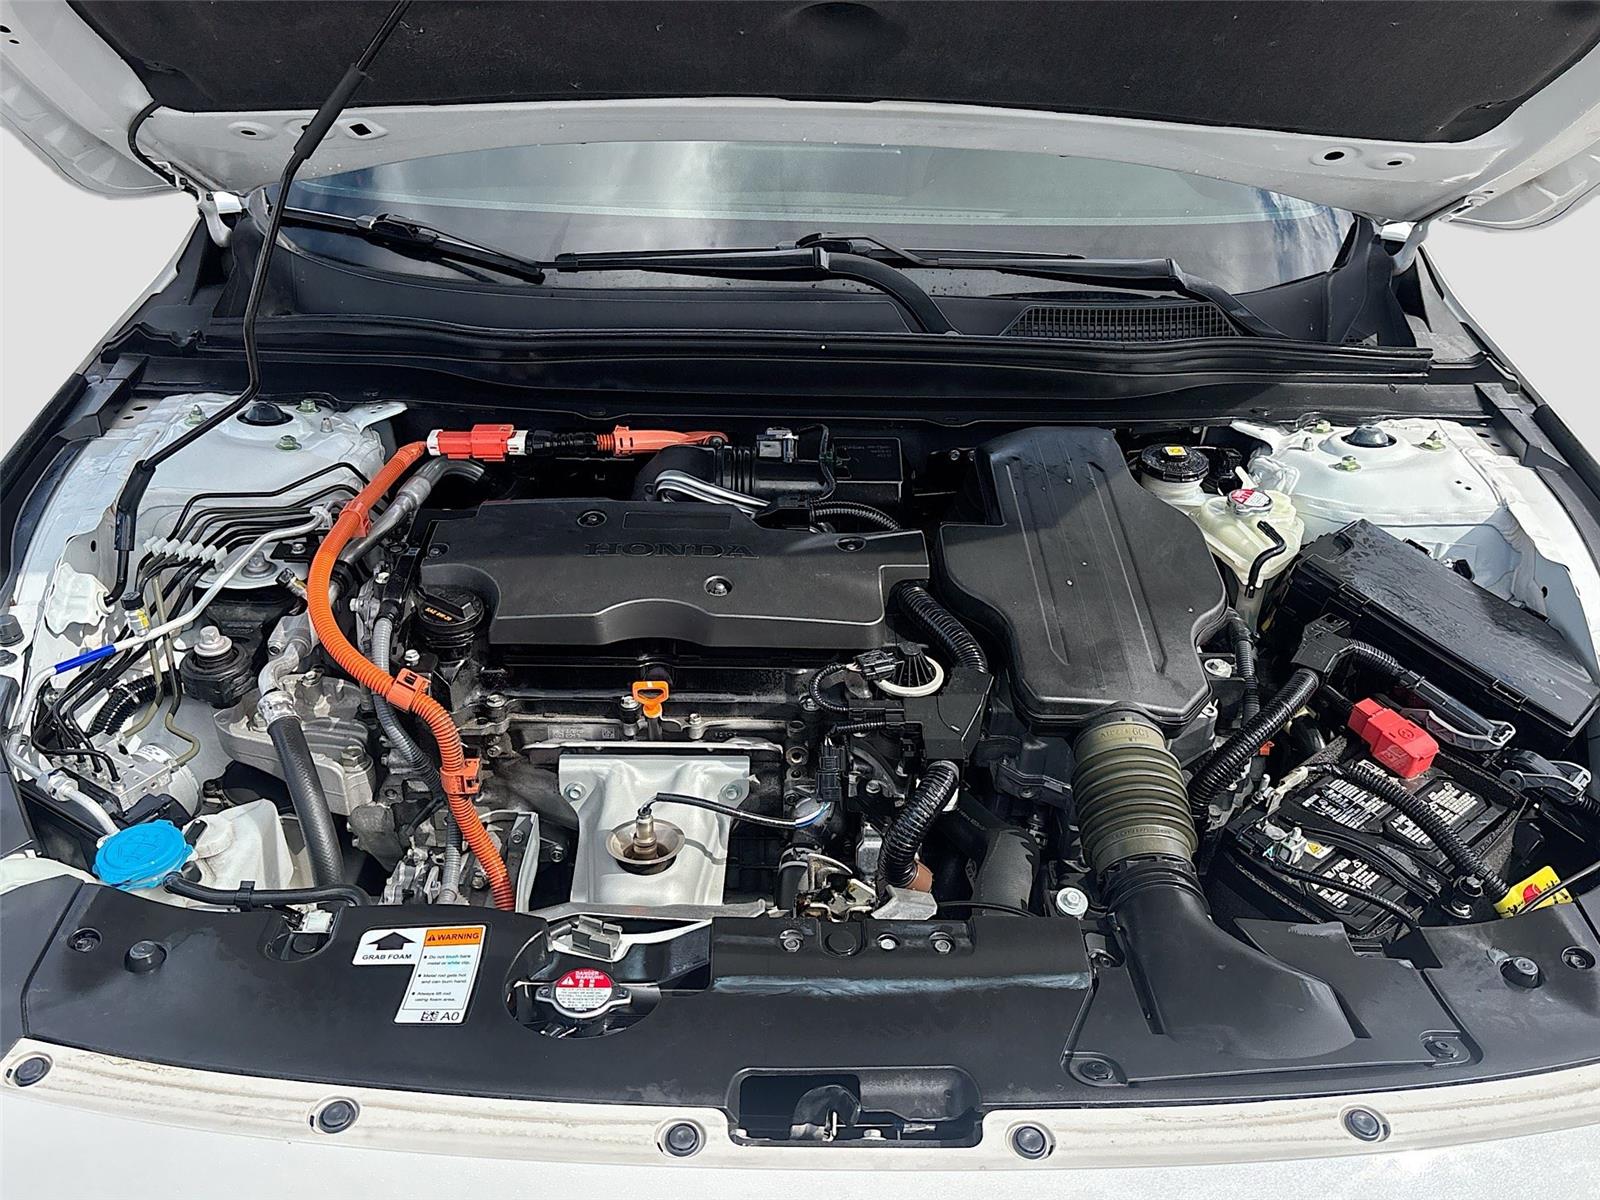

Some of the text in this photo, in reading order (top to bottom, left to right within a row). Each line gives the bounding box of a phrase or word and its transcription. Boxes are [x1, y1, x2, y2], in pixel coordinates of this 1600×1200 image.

[584, 541, 760, 559] HONDA
[436, 932, 480, 941] WARNING
[440, 1012, 460, 1021] A0
